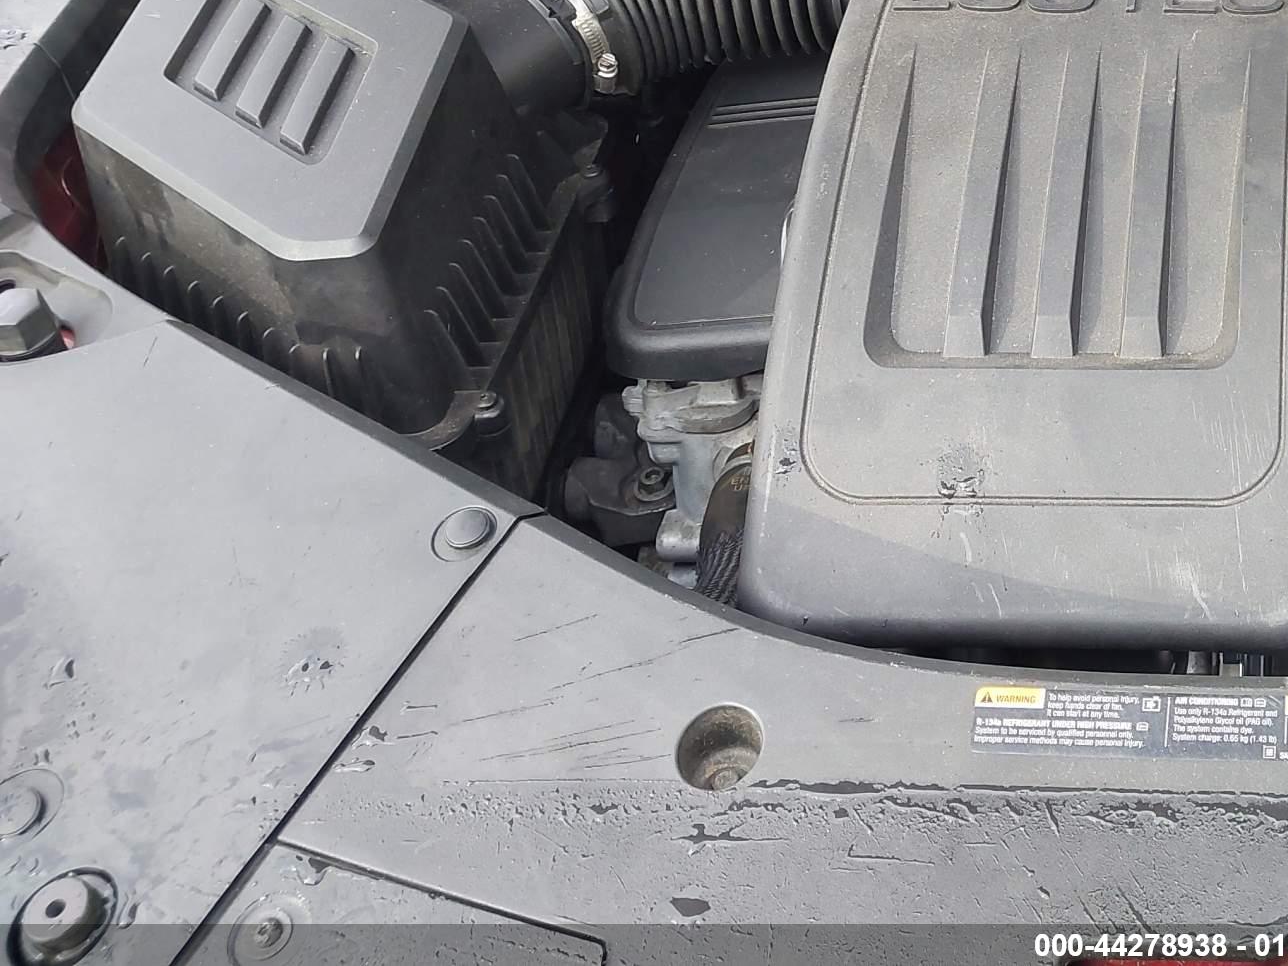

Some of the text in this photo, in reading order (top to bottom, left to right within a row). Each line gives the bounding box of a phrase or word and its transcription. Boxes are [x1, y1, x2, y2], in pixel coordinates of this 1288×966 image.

[996, 695, 1036, 703] WARNING
[1058, 694, 1071, 702] help
[1073, 694, 1090, 702] avoid
[1092, 695, 1119, 703] personal
[1189, 697, 1238, 706] CONDITIONING
[1091, 711, 1102, 719] any
[1175, 707, 1186, 715] Use
[1188, 708, 1201, 716] only
[1003, 719, 1051, 727] REFRIGERANT
[1052, 720, 1075, 728] UNDER
[1077, 721, 1095, 729] HIGH
[1096, 721, 1132, 730] PRESSURE
[1215, 717, 1235, 725] Glycol
[975, 727, 999, 735] System
[1019, 728, 1046, 736] serviced
[1047, 729, 1055, 737] by
[1057, 729, 1084, 737] qualified
[1086, 730, 1117, 738] personnel
[1187, 725, 1210, 733] system
[974, 735, 1003, 743] Improper
[1005, 736, 1028, 744] service
[1030, 737, 1057, 745] methods
